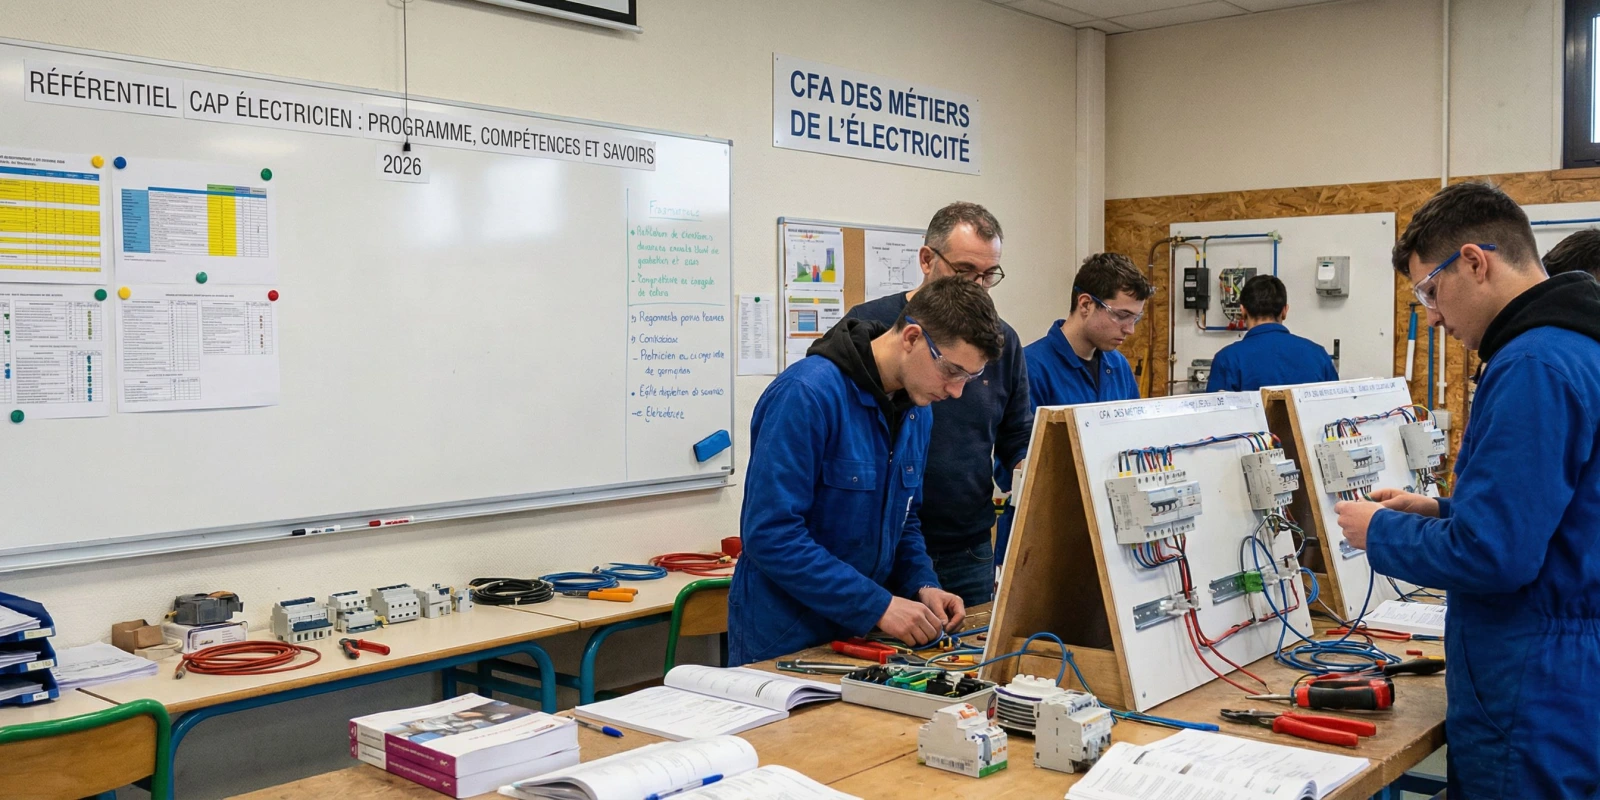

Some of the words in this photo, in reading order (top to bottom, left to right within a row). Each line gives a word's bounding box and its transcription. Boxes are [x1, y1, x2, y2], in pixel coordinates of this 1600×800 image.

[30, 67, 177, 109] RÉFÉRENTIEL
[190, 90, 229, 114] CAP
[236, 91, 352, 129] ÉLECTRICIEN
[368, 112, 476, 146] PROGRAMME,
[481, 126, 581, 156] COMPÉTENCES
[585, 140, 600, 158] ET
[603, 142, 655, 165] SAVOIRS
[790, 70, 835, 103] CFA
[841, 79, 882, 112] DES
[889, 87, 970, 128] MÉTIERS
[791, 109, 821, 140] DE
[383, 154, 422, 176] 2026
